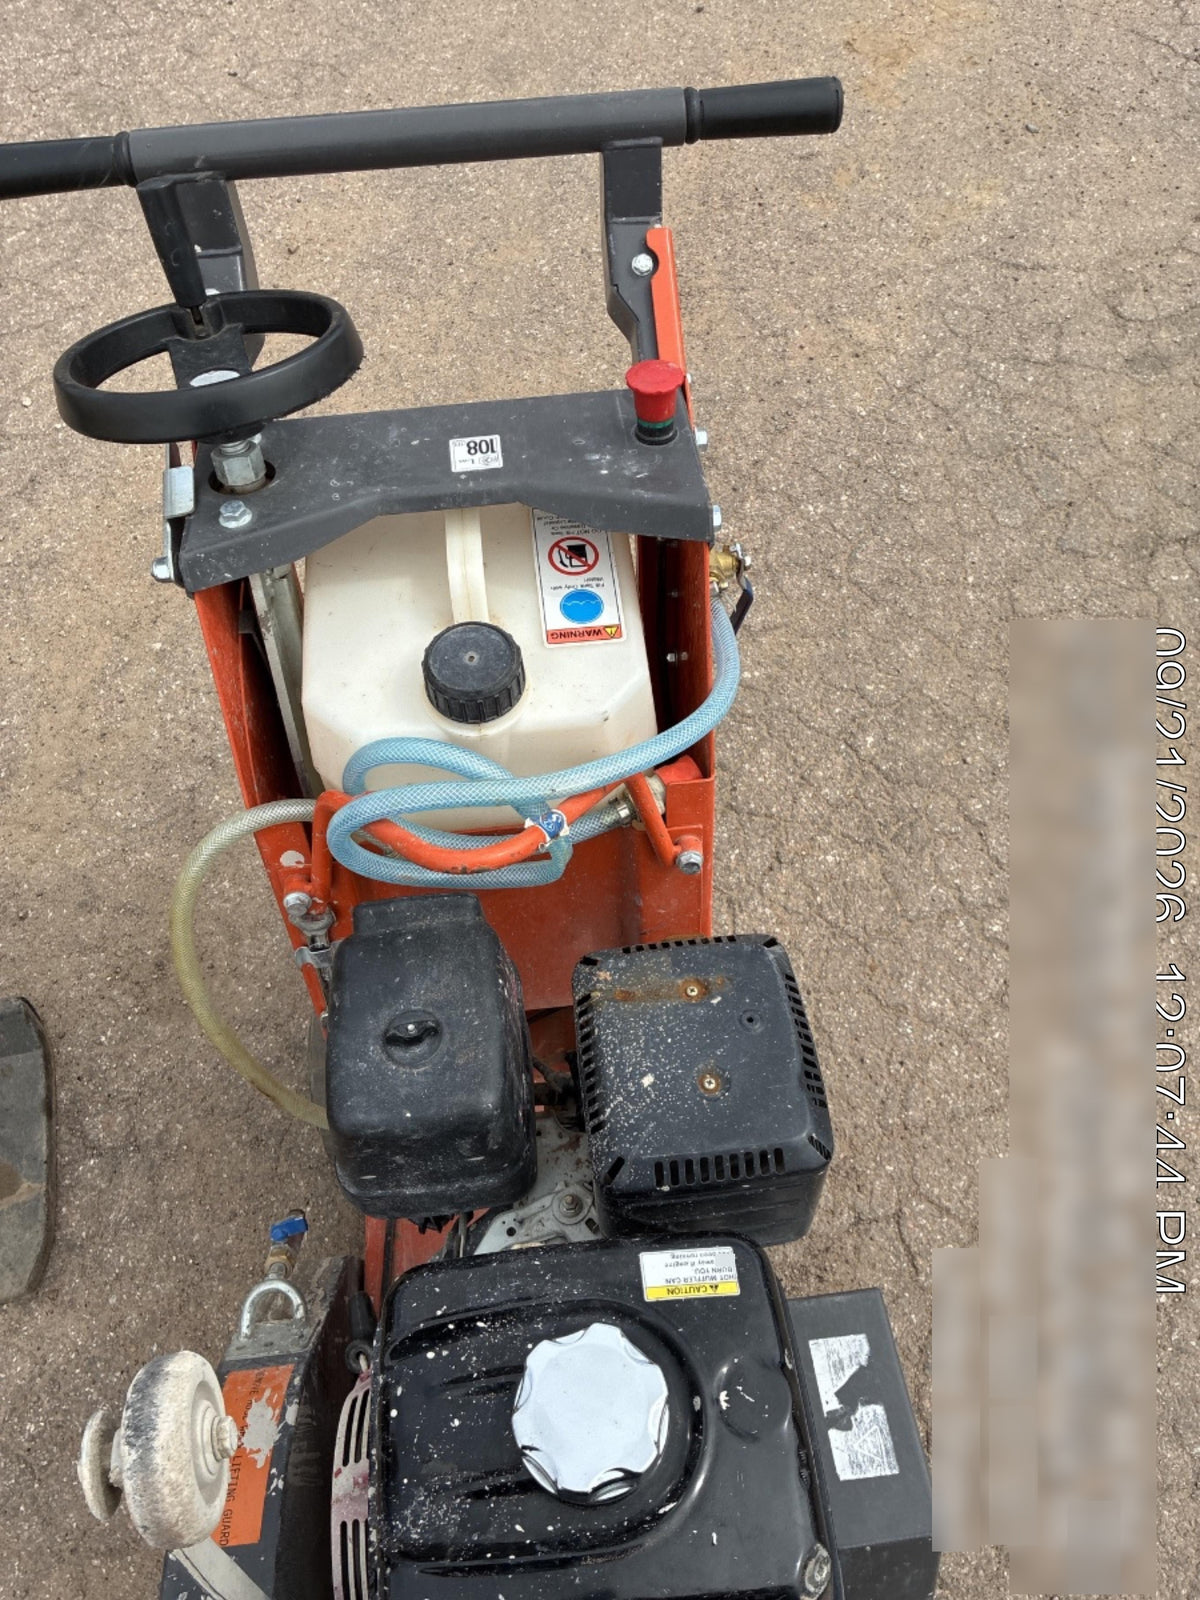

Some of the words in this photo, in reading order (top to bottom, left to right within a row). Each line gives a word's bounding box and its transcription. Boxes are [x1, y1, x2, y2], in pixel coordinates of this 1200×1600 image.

[466, 438, 496, 456] 108
[550, 628, 603, 640] WARNING
[666, 1284, 708, 1296] CAUTION
[227, 1455, 242, 1503] LIFTING
[219, 1509, 233, 1546] GUARD
